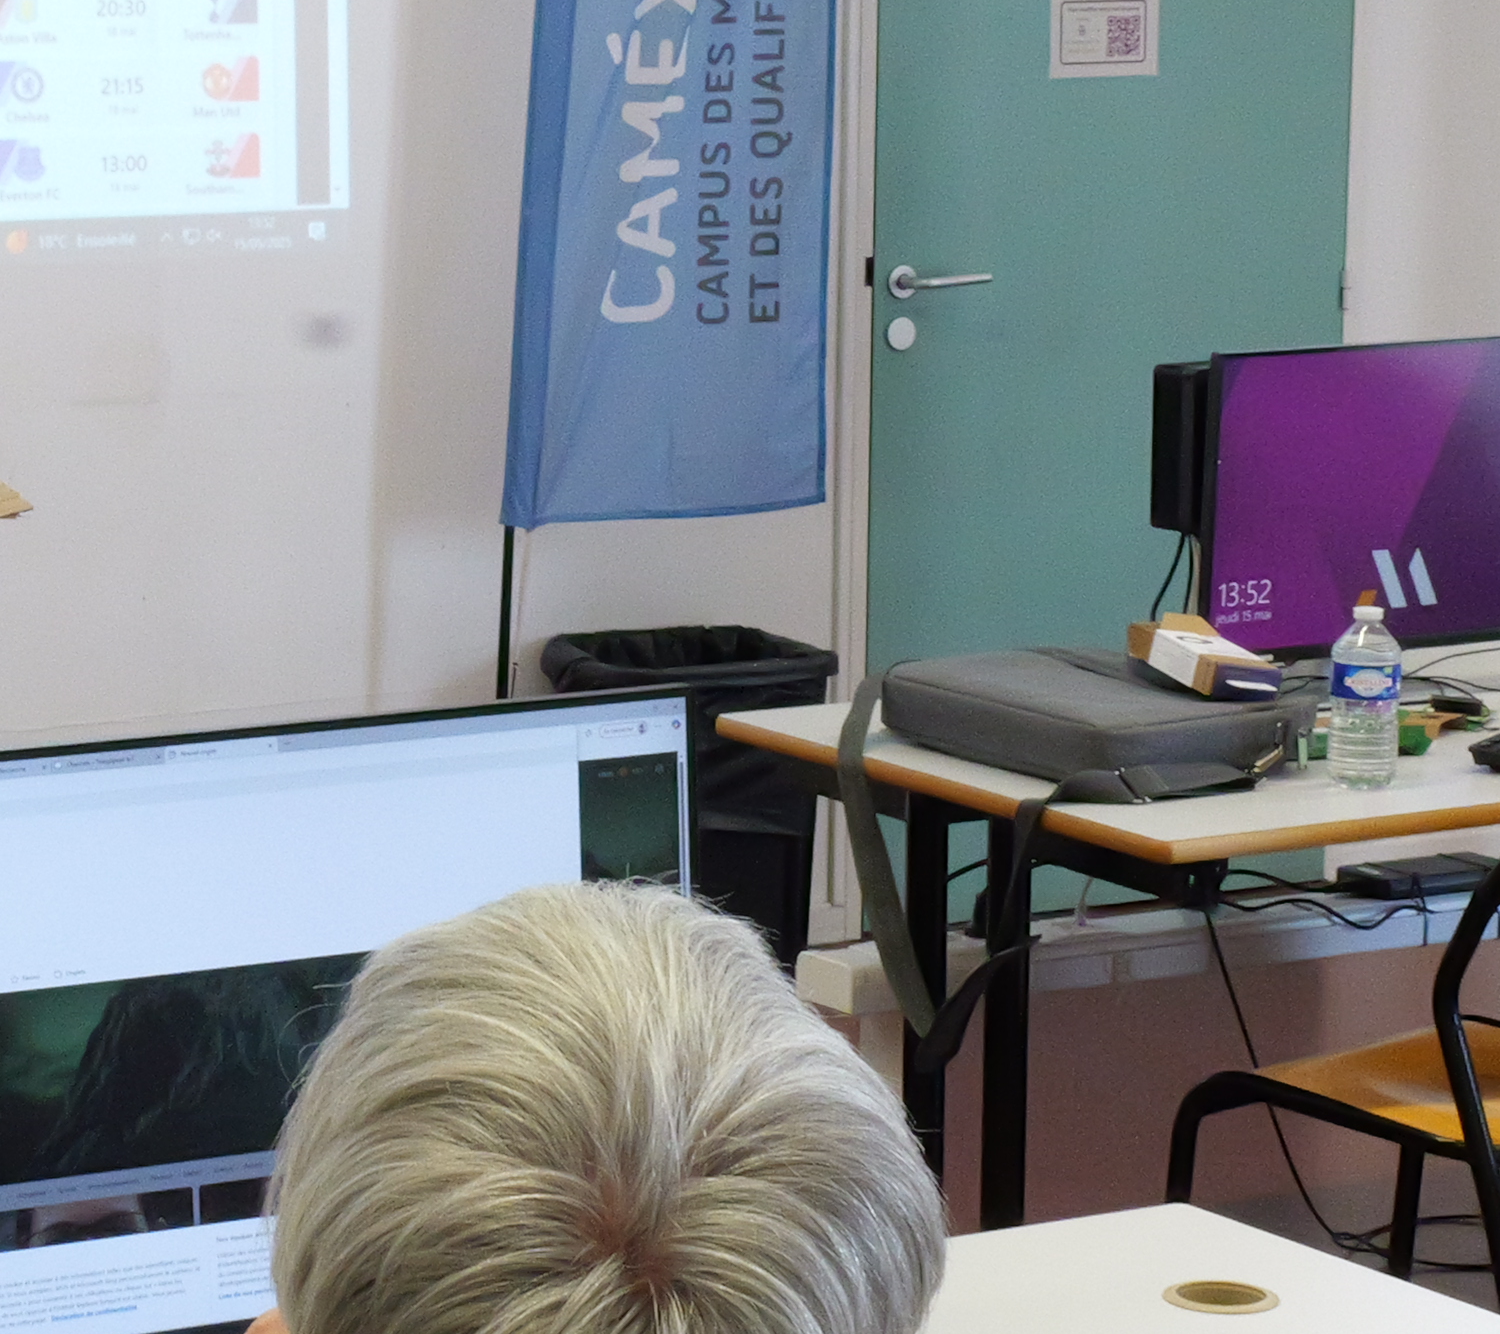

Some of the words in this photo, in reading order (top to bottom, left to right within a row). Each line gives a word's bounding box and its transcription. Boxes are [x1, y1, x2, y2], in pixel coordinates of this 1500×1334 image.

[100, 77, 145, 97] 21:15
[704, 42, 736, 125] DES
[5, 110, 50, 124] Chelsea
[100, 154, 148, 175] 13:00
[44, 187, 61, 201] FC
[749, 176, 784, 256] DES
[696, 141, 731, 325] CAMPUS
[749, 274, 781, 323] ET
[1219, 579, 1272, 608] 13:52
[1215, 610, 1239, 627] jeudi
[1242, 611, 1252, 622] 15
[1254, 611, 1272, 621] mai
